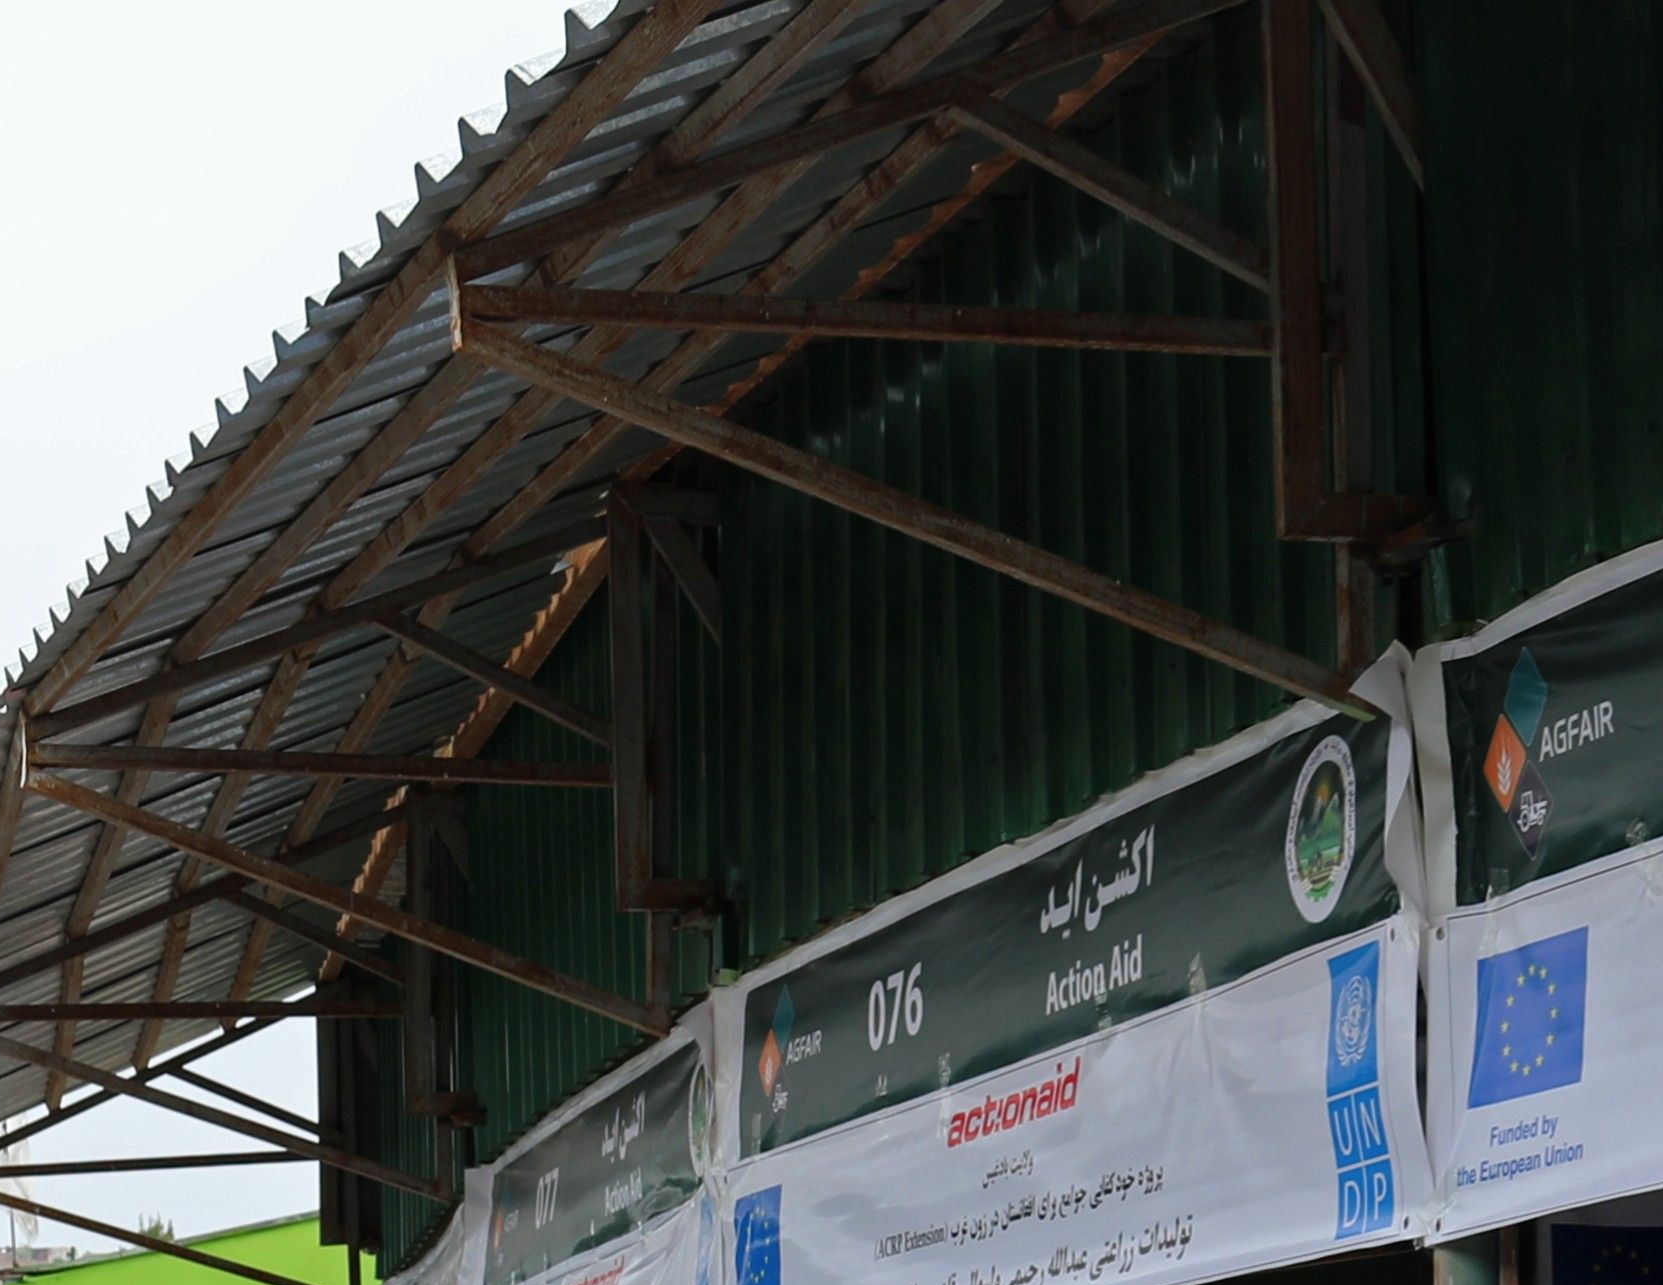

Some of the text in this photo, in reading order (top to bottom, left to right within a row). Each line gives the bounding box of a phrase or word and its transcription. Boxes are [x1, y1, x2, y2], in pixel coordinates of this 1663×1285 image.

[1539, 699, 1614, 762] AGFAIR
[1045, 933, 1143, 1016] Action Aid
[868, 961, 924, 1053] 076
[786, 1030, 822, 1067] AGFAIR
[947, 1055, 1082, 1149] actionaid
[1489, 1114, 1559, 1147] Funded by
[1456, 1142, 1584, 1187] the European Union
[535, 1167, 560, 1229] 077
